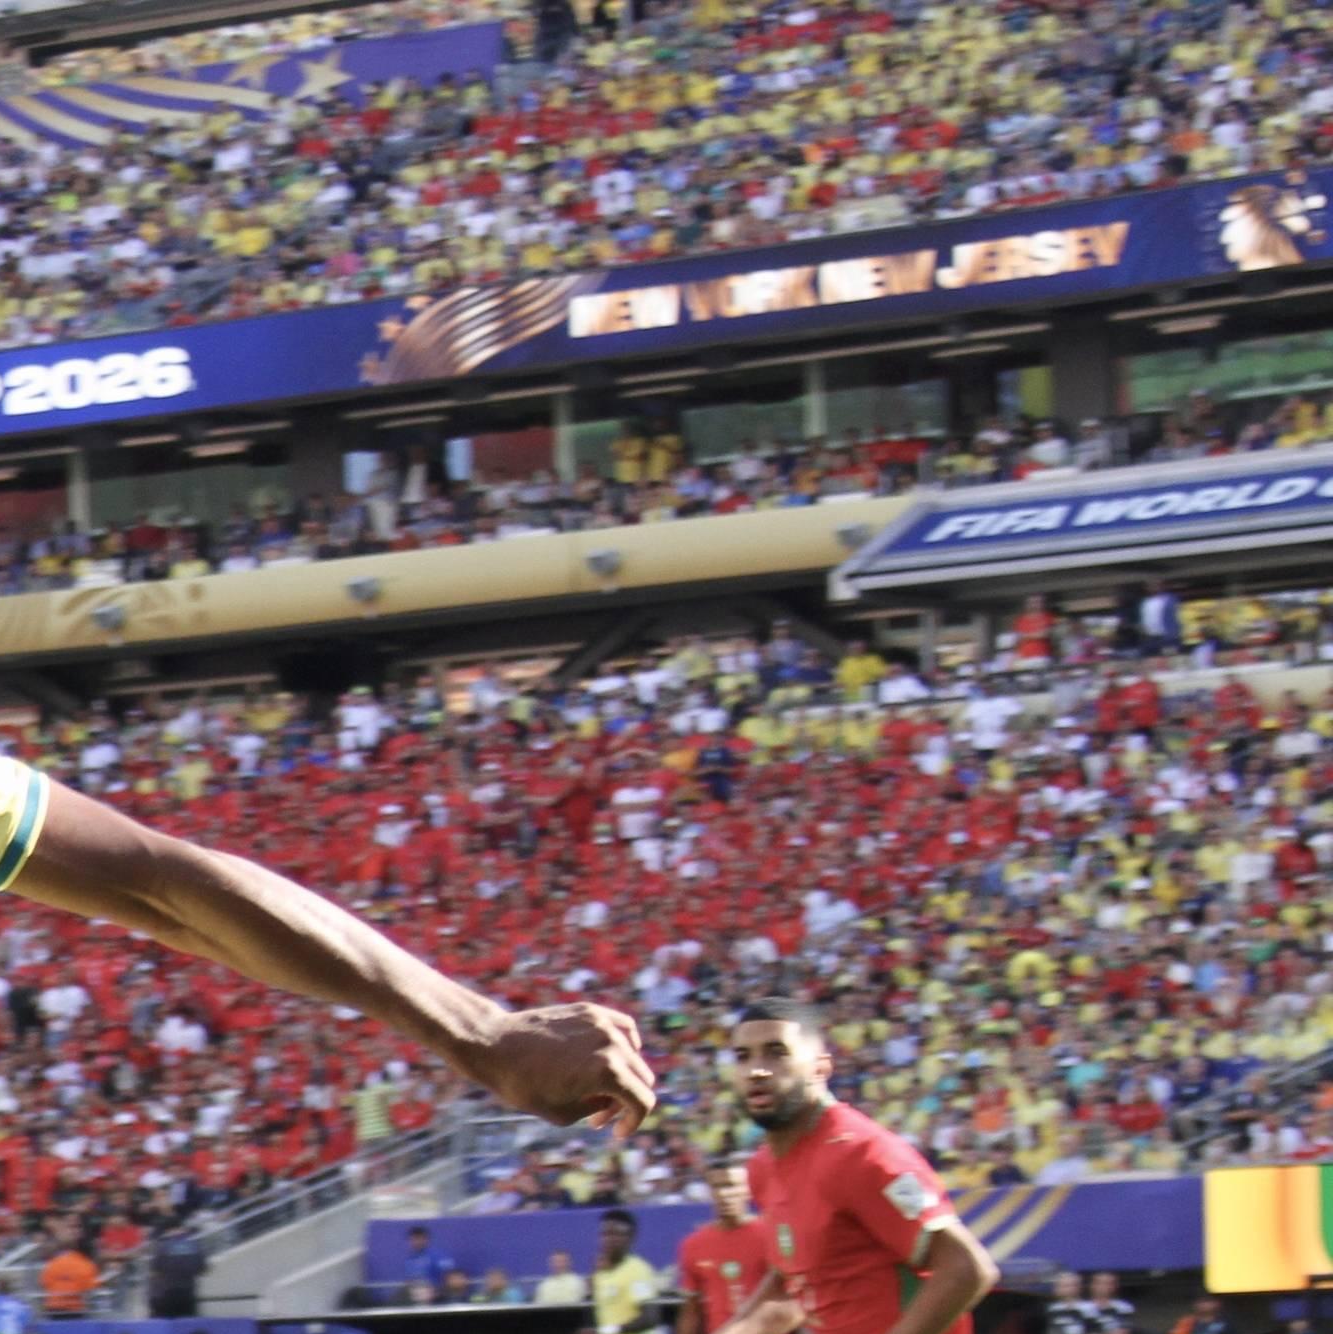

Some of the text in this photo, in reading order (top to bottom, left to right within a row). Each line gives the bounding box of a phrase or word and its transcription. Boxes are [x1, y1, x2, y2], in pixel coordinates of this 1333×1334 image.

[567, 221, 1130, 338] NEW YORK NEW JERSEY
[3, 347, 191, 416] 2026
[922, 505, 1071, 543] FIFA
[1071, 476, 1319, 528] WORLD
